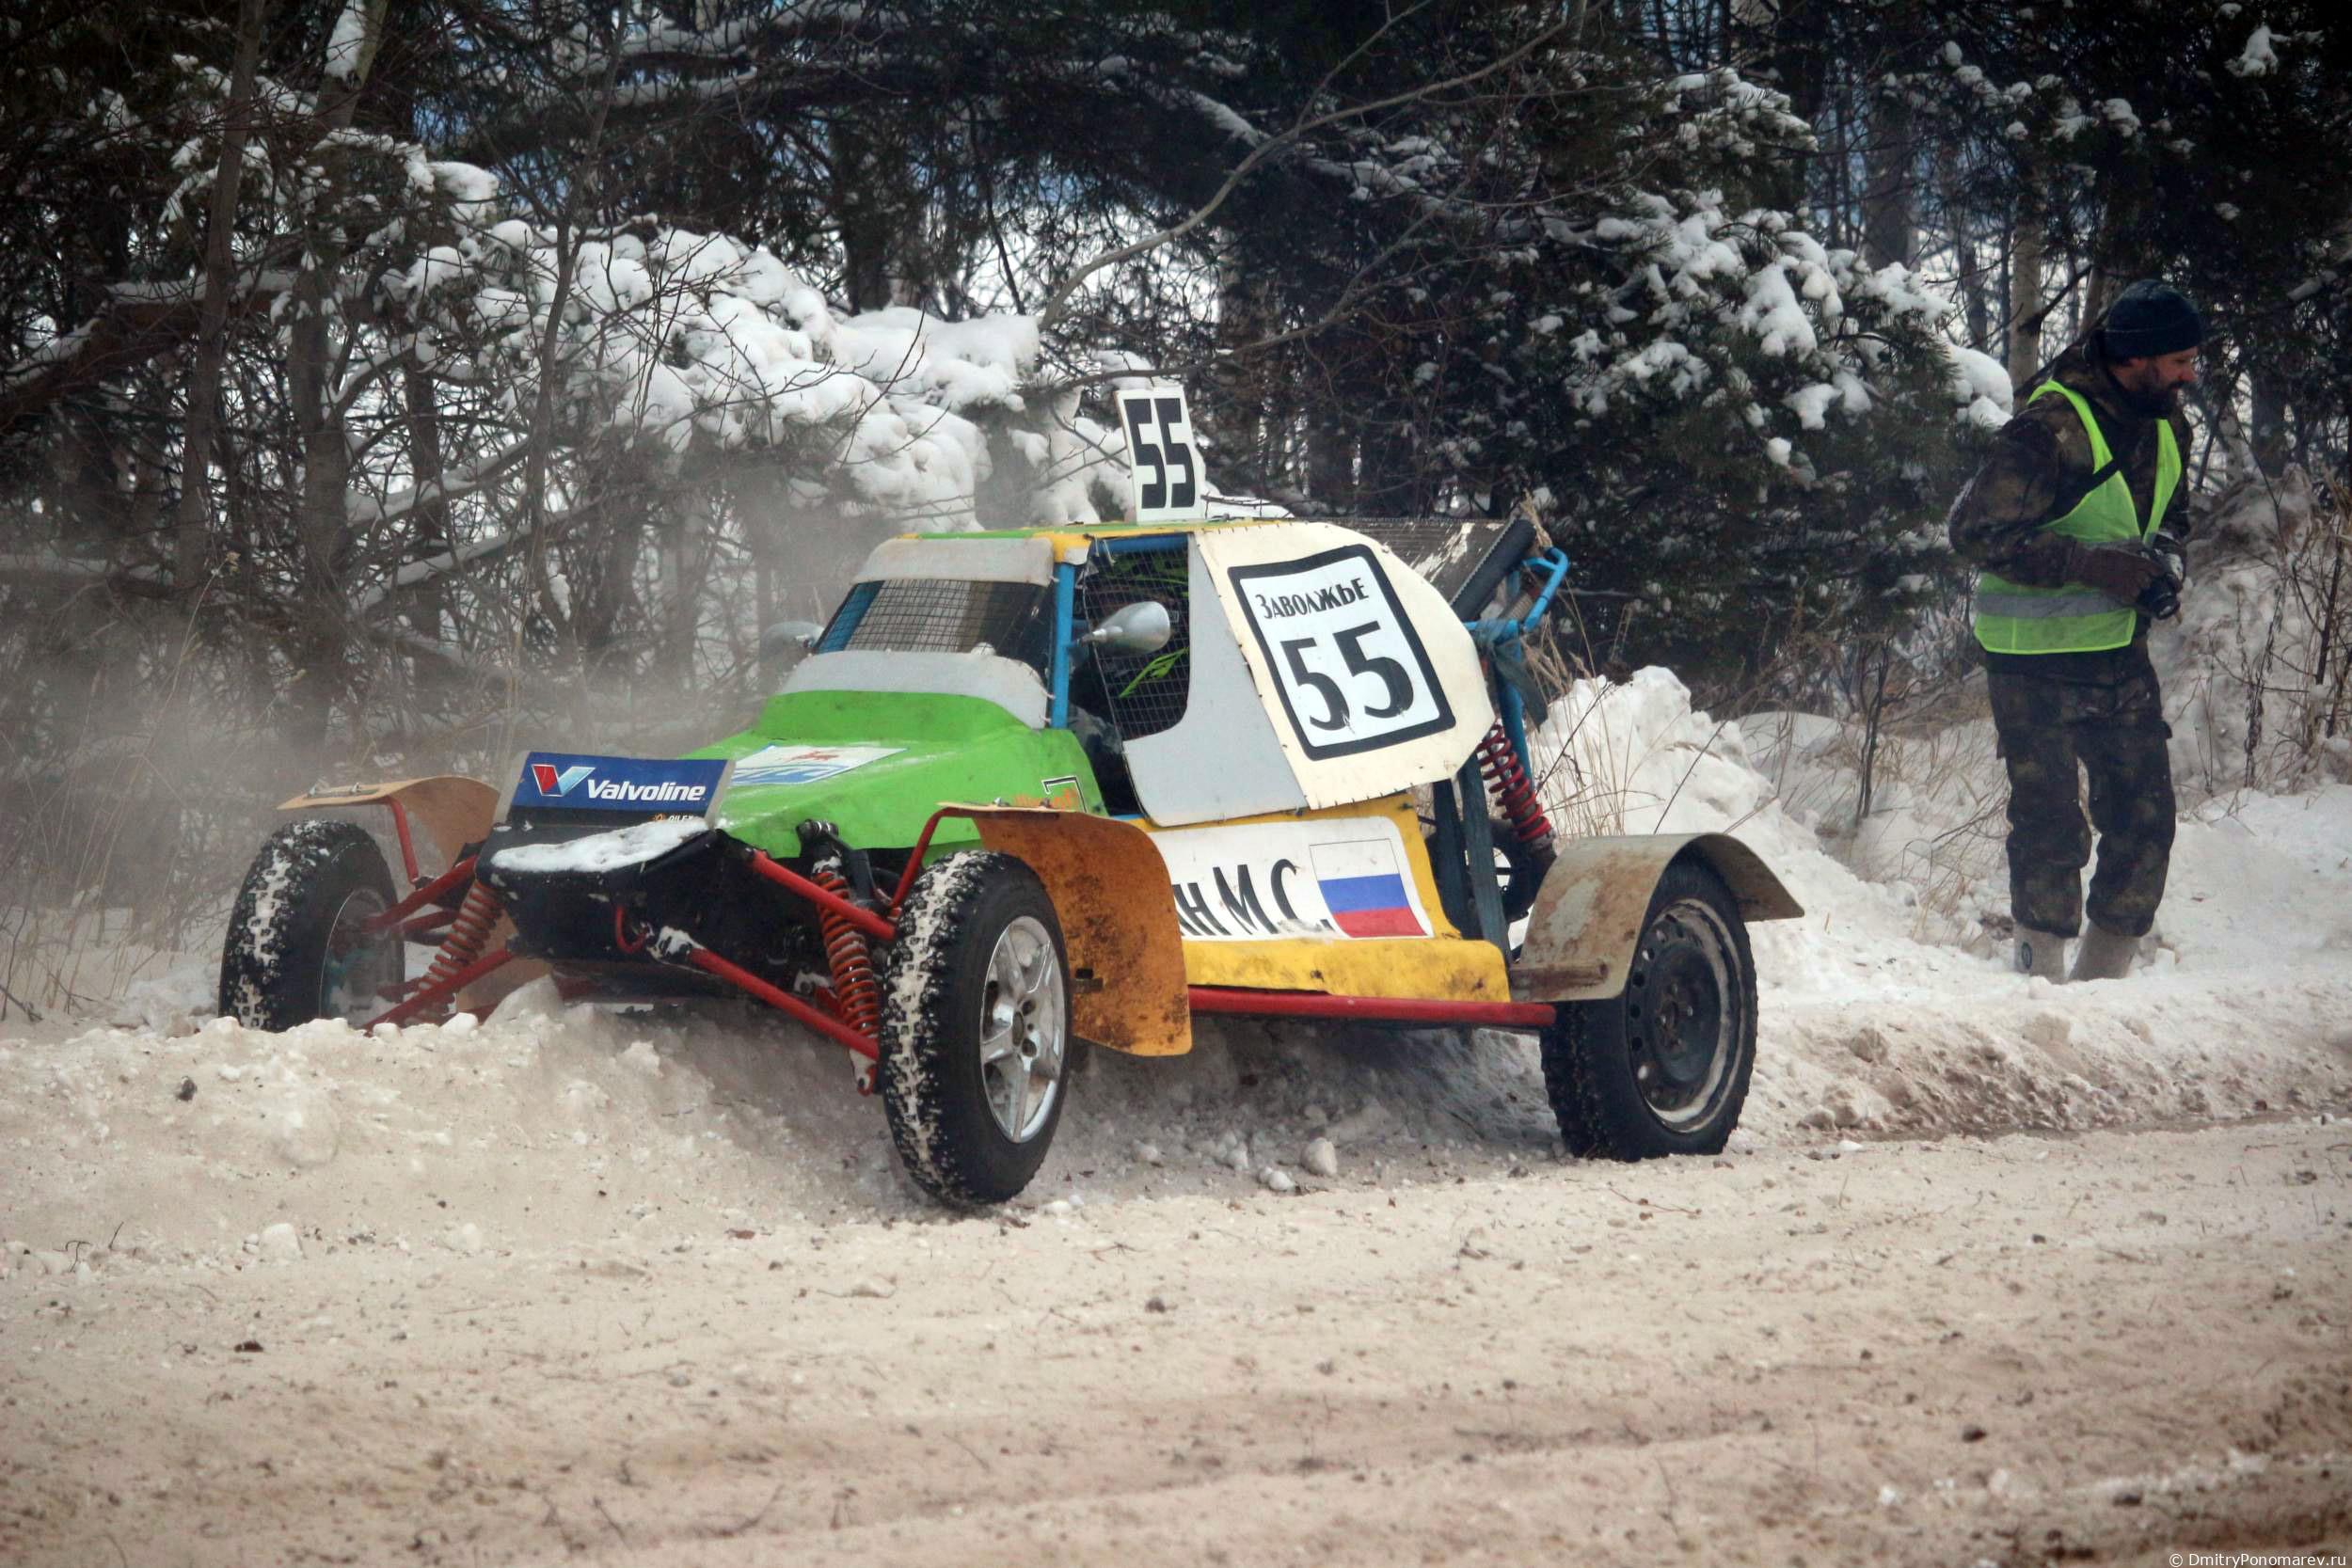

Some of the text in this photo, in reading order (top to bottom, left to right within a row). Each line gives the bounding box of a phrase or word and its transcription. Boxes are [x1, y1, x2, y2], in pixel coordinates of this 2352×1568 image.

[1123, 398, 1196, 509] 55
[1279, 621, 1414, 731] 55
[587, 780, 707, 801] Valvoline
[1171, 859, 1335, 936] НМС
